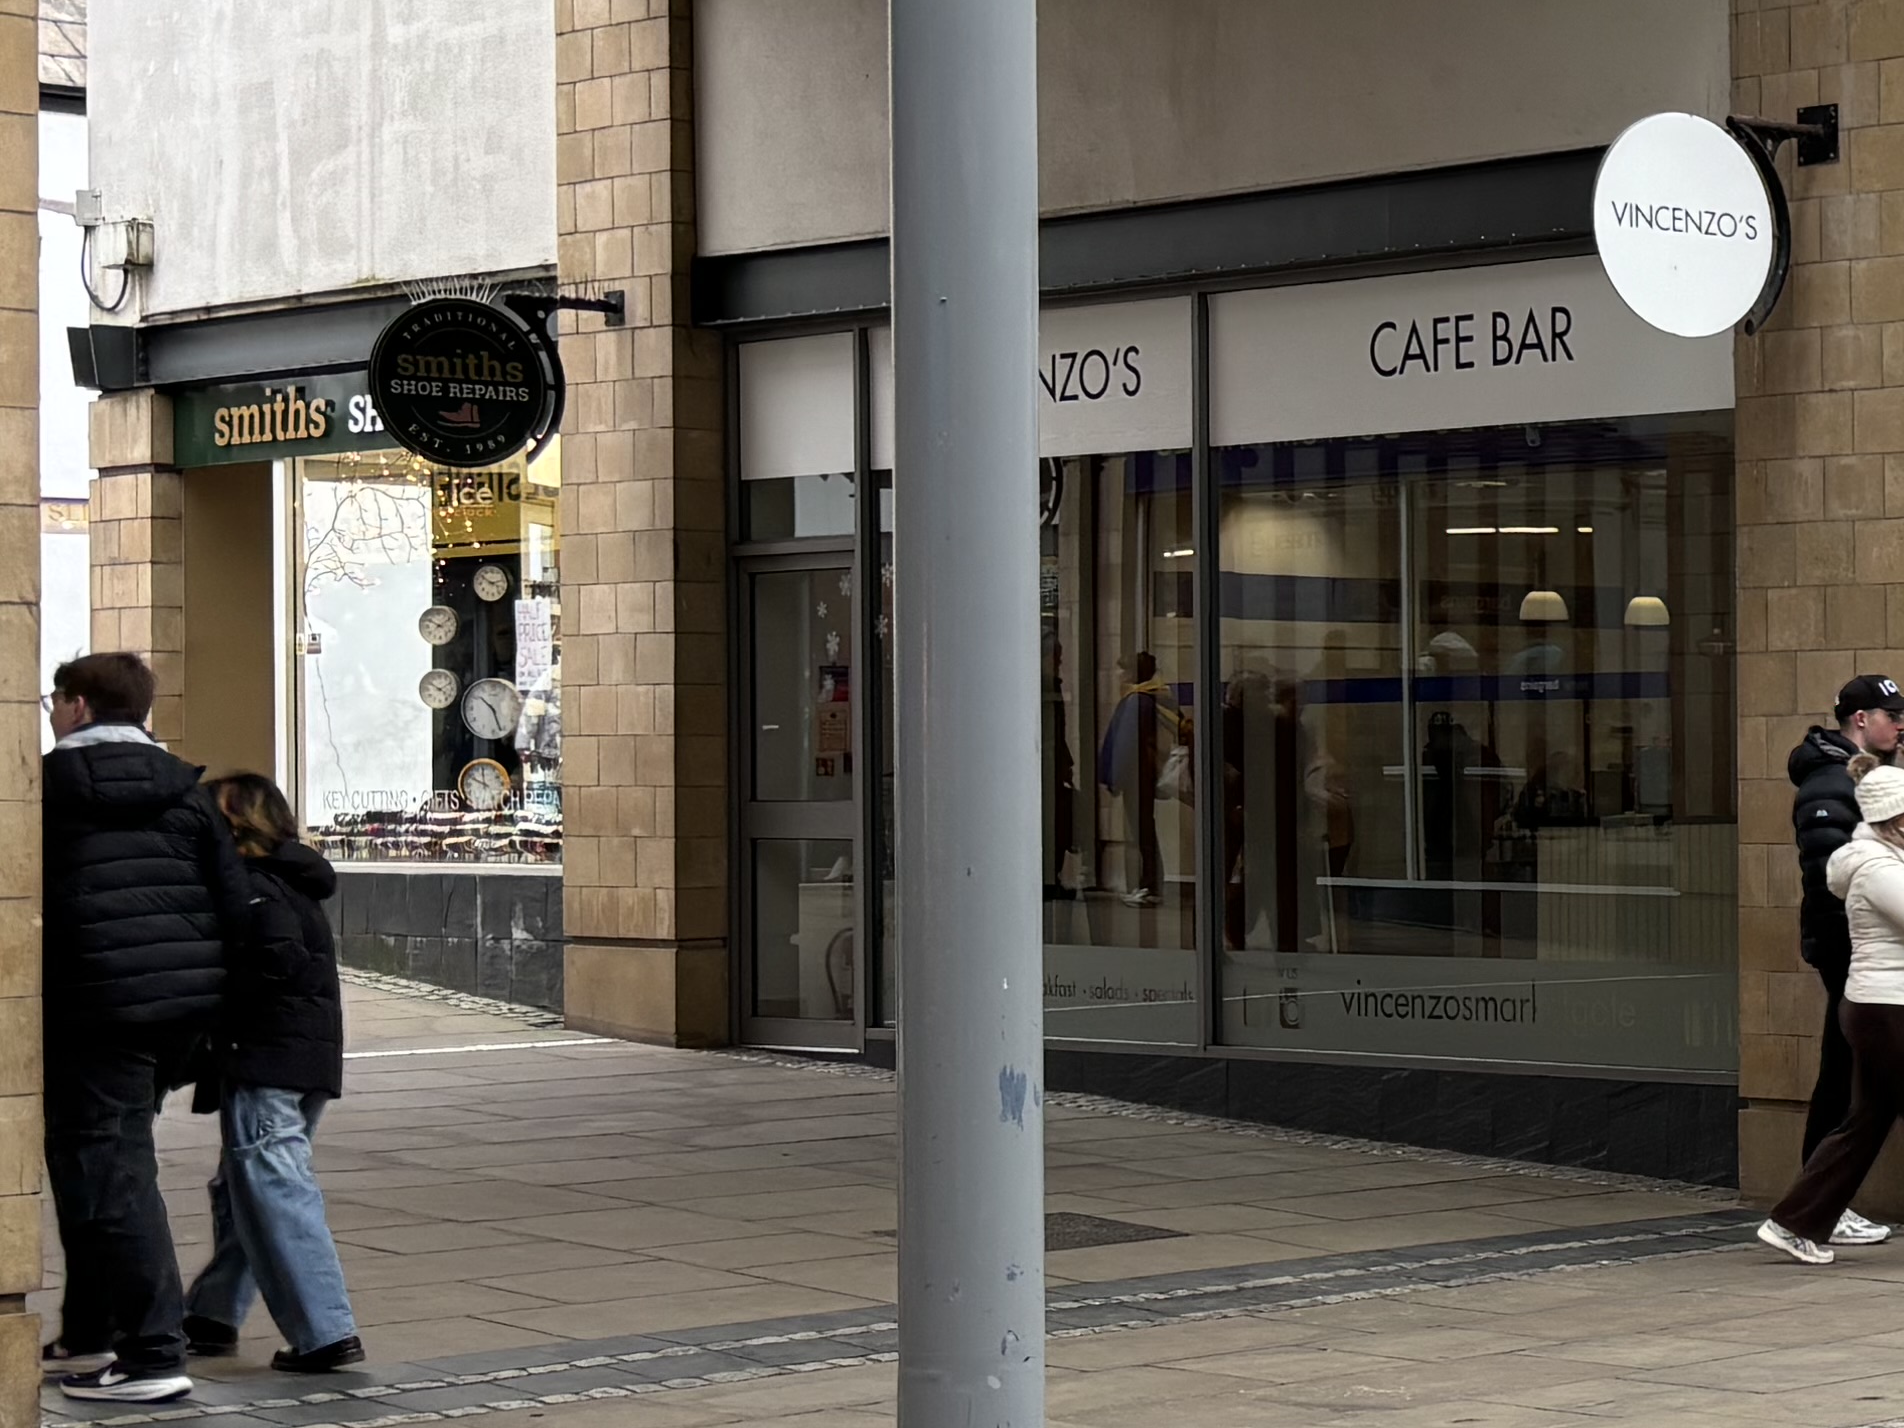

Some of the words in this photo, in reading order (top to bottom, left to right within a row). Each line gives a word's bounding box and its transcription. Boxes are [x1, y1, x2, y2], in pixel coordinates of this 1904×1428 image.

[1611, 200, 1759, 241] VINCENZO'S
[403, 310, 516, 351] TRADITIONAL
[1369, 313, 1475, 378] CAFE
[1491, 305, 1575, 367] BAR
[396, 348, 524, 384] smiths
[390, 379, 443, 397] SHOE
[449, 382, 530, 402] REPAIRS
[214, 385, 327, 447] smiths
[322, 790, 349, 811] KEY
[351, 789, 408, 811] CUTTING
